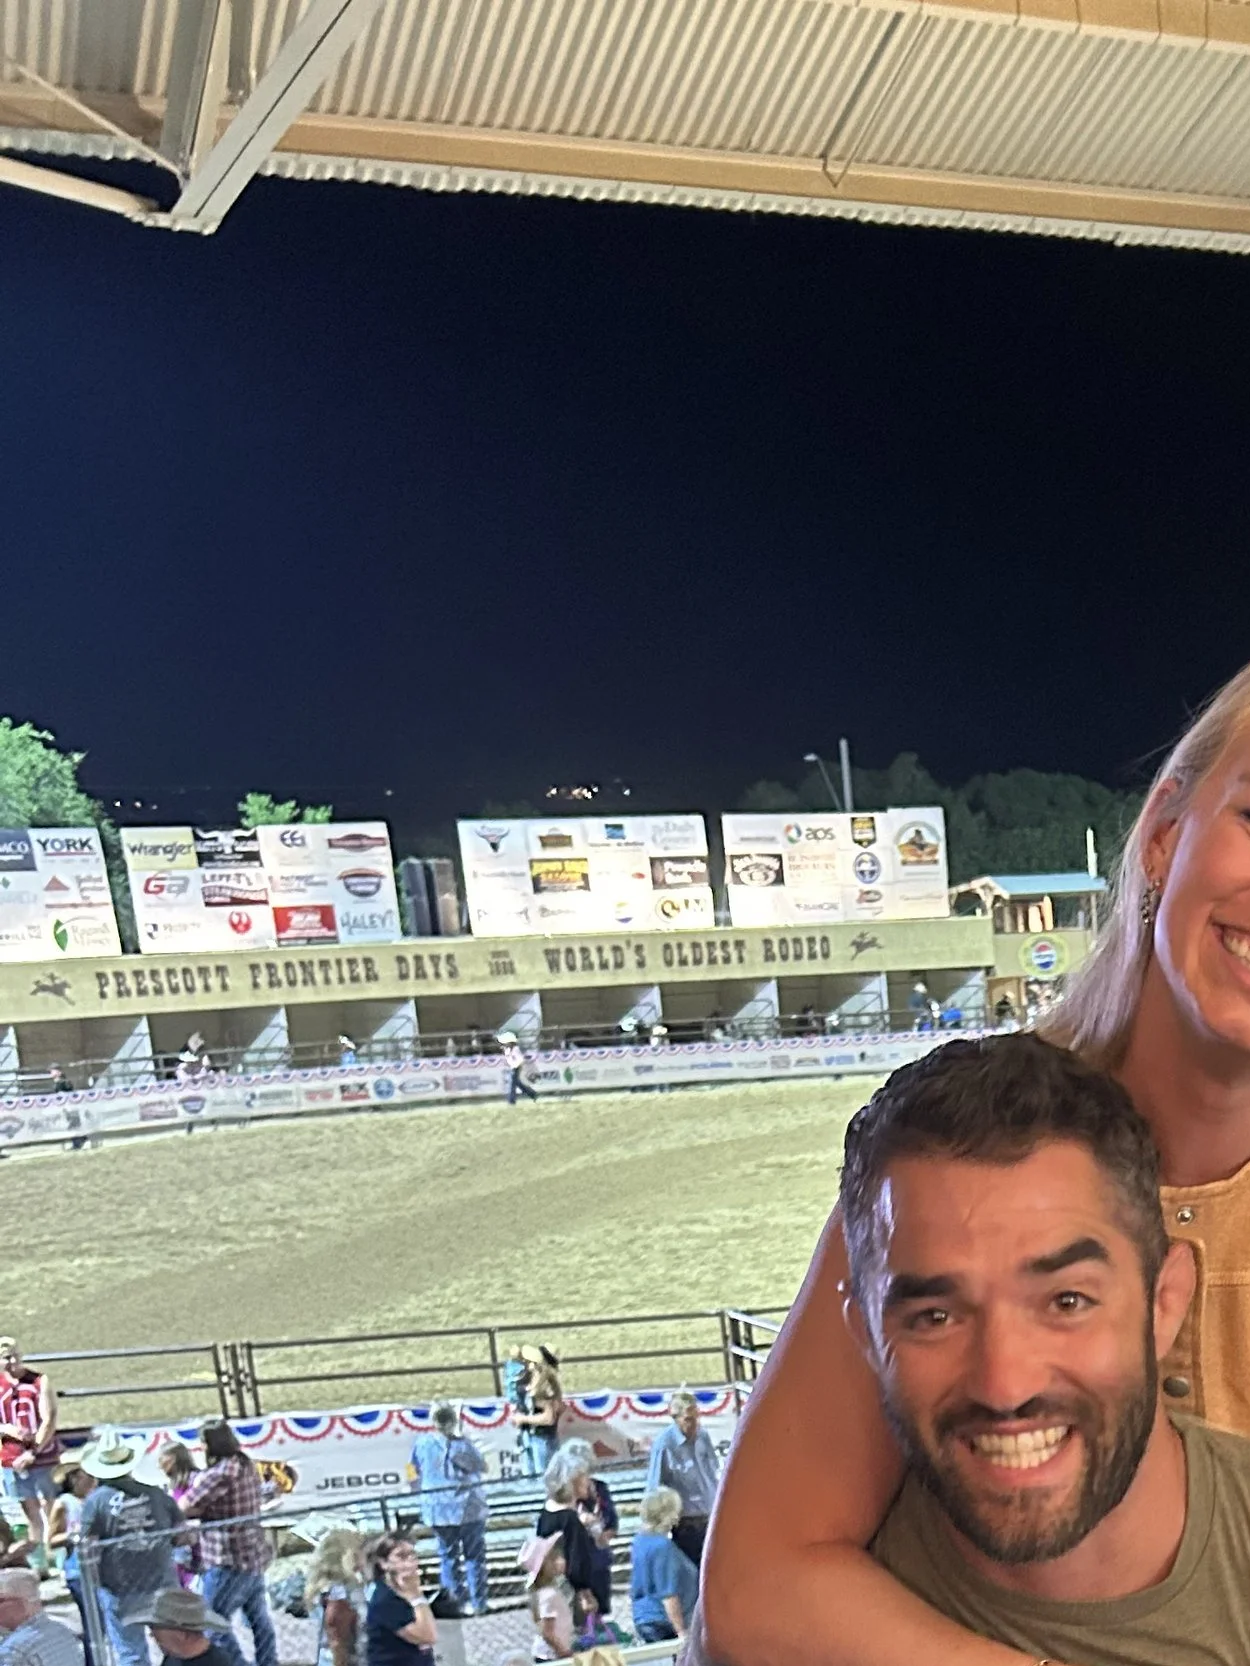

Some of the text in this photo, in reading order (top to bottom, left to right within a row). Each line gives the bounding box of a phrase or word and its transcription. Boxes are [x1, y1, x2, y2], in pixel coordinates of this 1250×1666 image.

[36, 837, 94, 852] YORK
[543, 935, 831, 973] WORLD'S OLDEST RODEO
[95, 953, 460, 999] PRESCOTT FRONTIER DAYS
[316, 1472, 400, 1490] JEBCO
